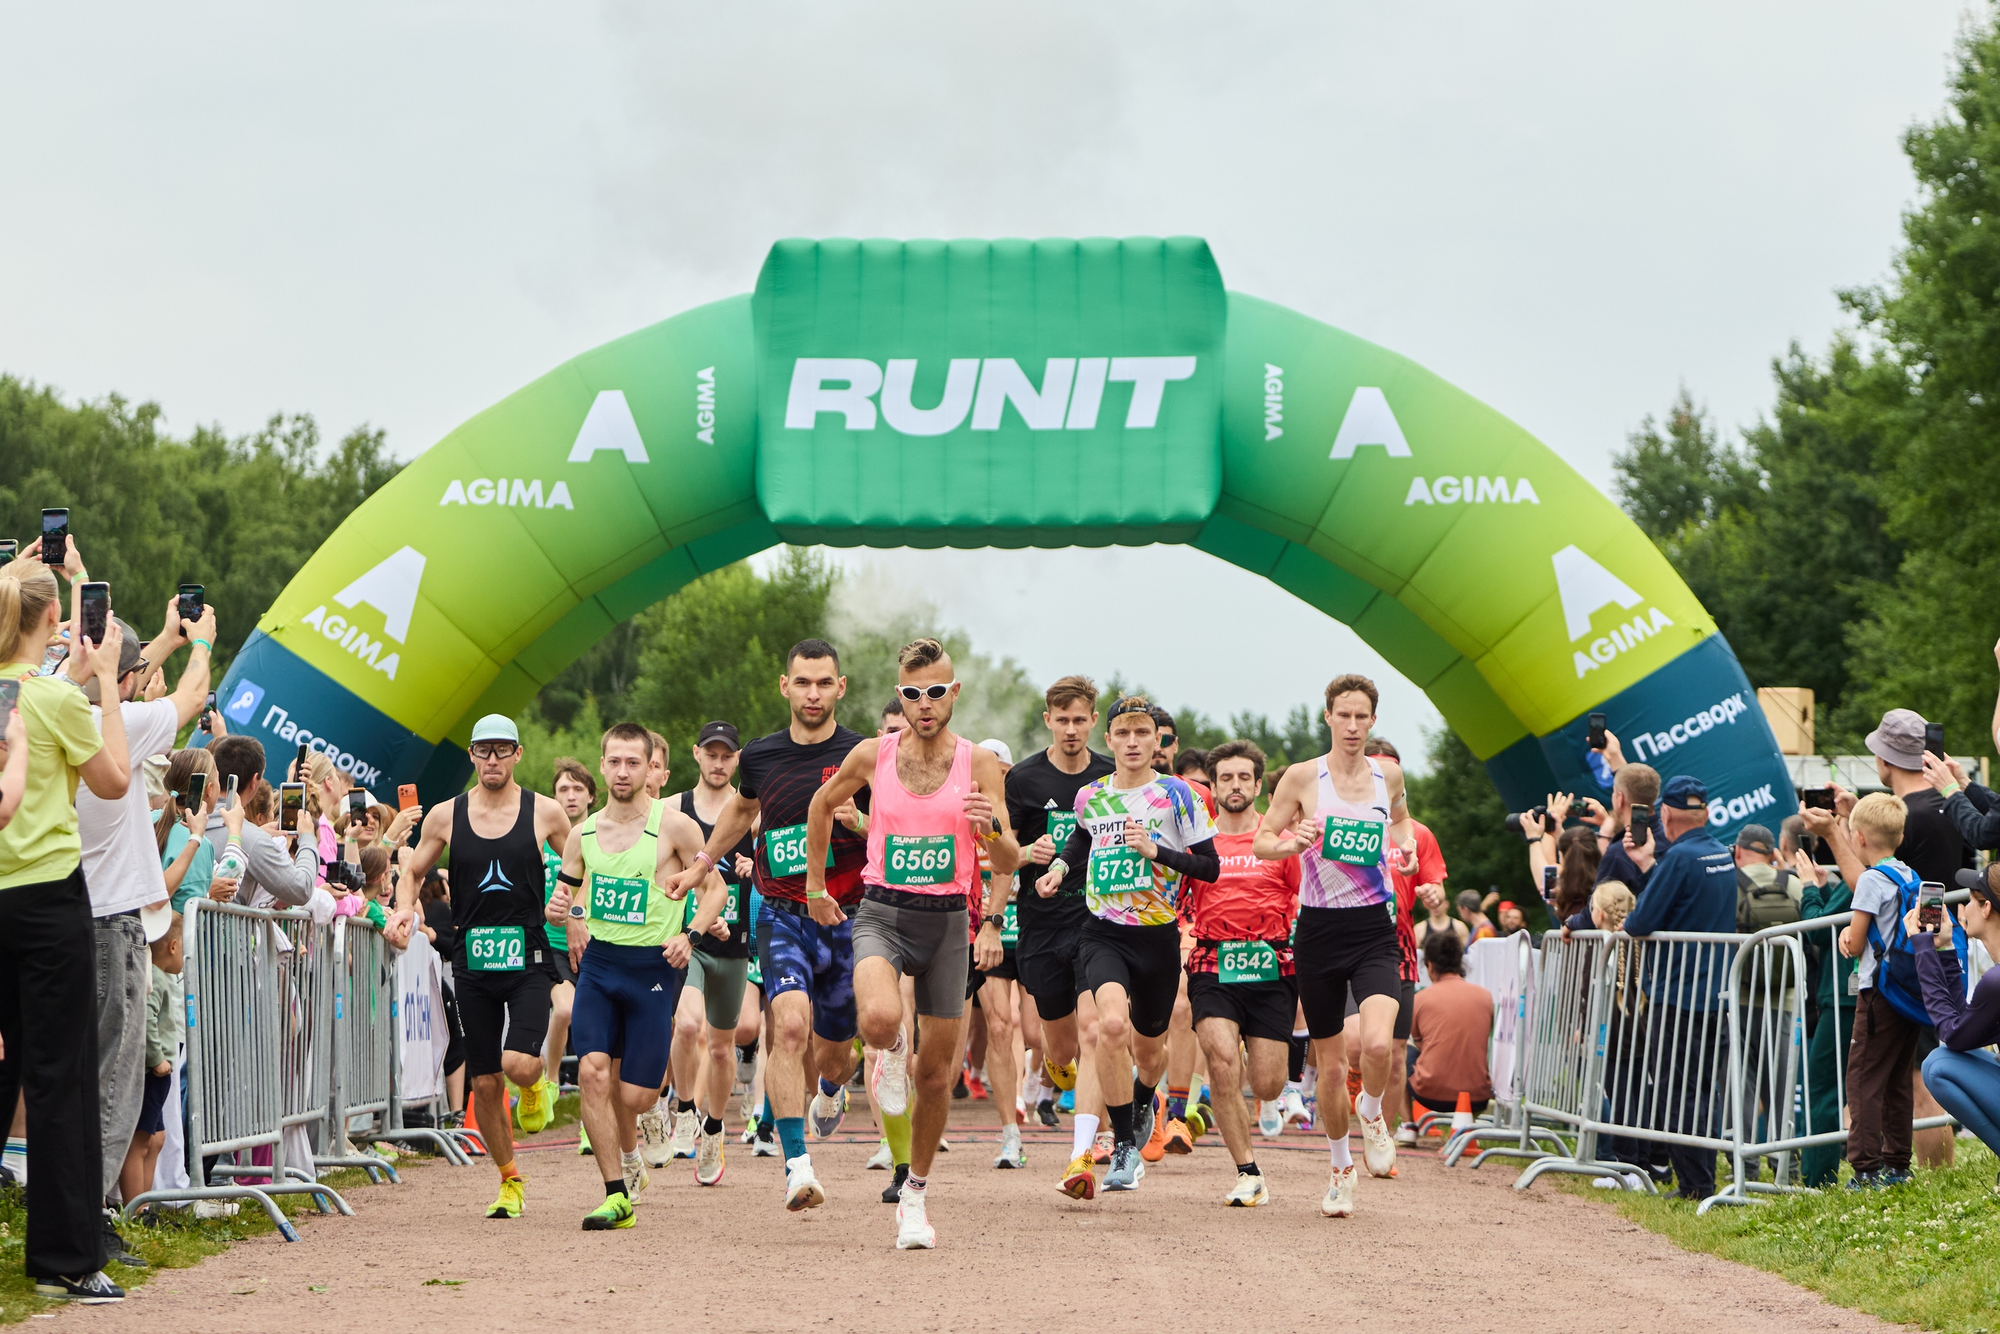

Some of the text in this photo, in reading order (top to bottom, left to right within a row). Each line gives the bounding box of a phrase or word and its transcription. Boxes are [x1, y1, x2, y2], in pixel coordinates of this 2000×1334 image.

[696, 366, 716, 445] AGIMA
[785, 356, 1196, 436] RUNIT
[1263, 362, 1283, 441] AGIMA
[439, 477, 575, 511] AGIMA
[1405, 475, 1541, 506] AGIMA
[301, 604, 401, 681] AGIMA
[1572, 606, 1675, 679] AGIMA
[1631, 692, 1748, 763] Пассворк
[261, 704, 381, 787] Пассворк
[1332, 817, 1359, 827] RUNIT
[771, 827, 796, 839] RUNIT
[892, 835, 922, 844] RUNIT
[1329, 829, 1380, 853] 6550
[891, 848, 951, 870] 6569
[1218, 854, 1263, 868] онтур
[1339, 853, 1365, 863] AGIMA
[905, 875, 935, 884] AGIMA
[1097, 857, 1146, 882] 5731
[595, 875, 619, 885] RUNIT
[1109, 882, 1136, 892] AGIMA
[594, 886, 643, 912] 5311
[602, 912, 627, 922] AGIMA
[470, 927, 496, 935] RUNIT
[471, 938, 522, 958] 6310
[483, 961, 508, 970] AGIMA
[1223, 951, 1274, 971] 6542
[1236, 973, 1262, 981] AGIMA
